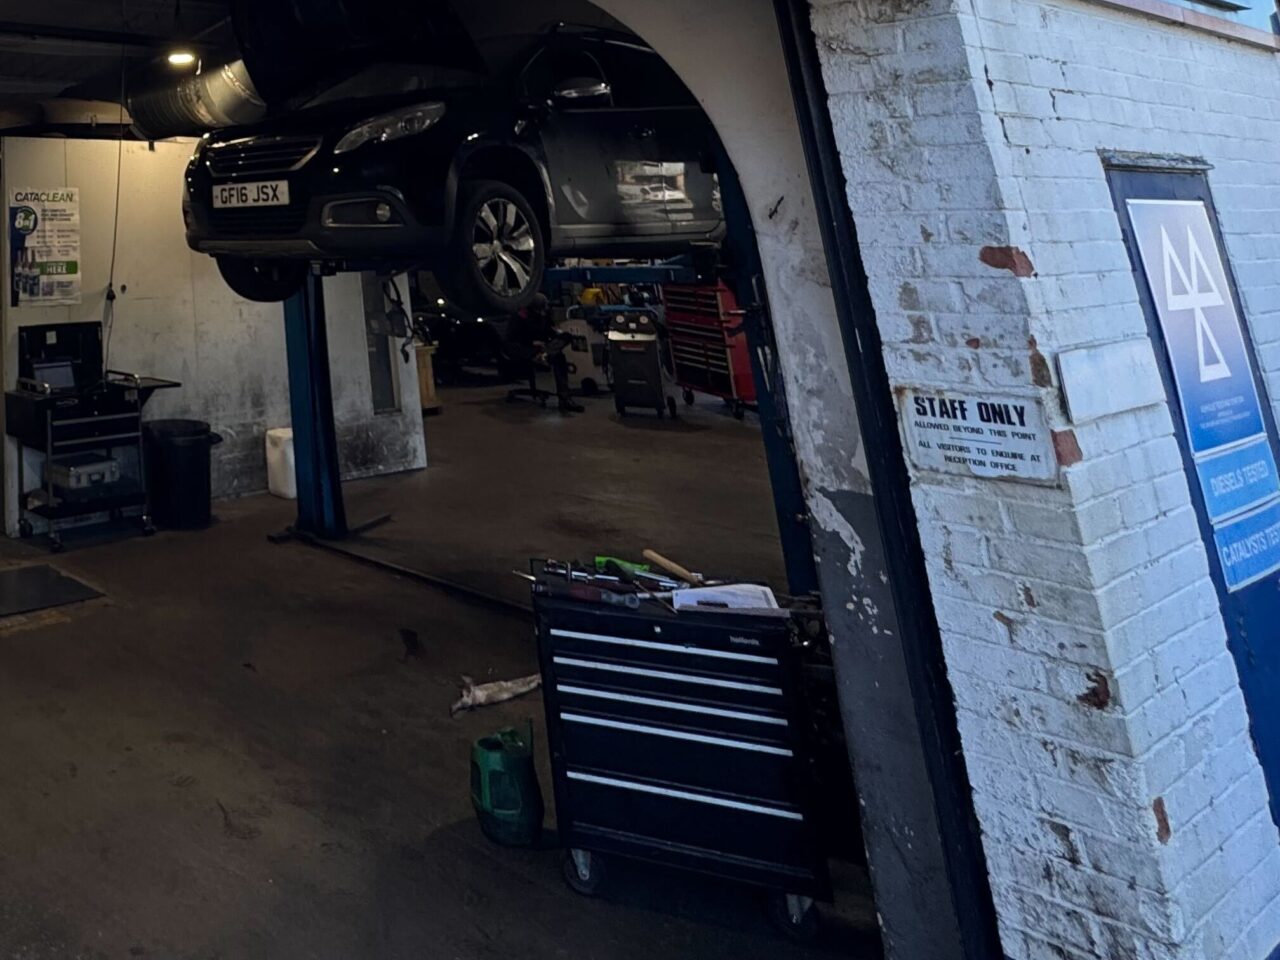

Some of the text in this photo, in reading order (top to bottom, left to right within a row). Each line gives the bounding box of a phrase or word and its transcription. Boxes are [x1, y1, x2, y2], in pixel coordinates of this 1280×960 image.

[15, 191, 74, 202] CATACLEAN
[221, 184, 280, 204] GF16 JSX
[914, 396, 1026, 427] STAFF ONLY
[914, 421, 1037, 440] ALLOWED BEYOND THIS POINT
[918, 440, 1040, 462] ALL VISITORS TO ENQUIRE AT
[944, 454, 1017, 472] RECEPTION OFFICE
[1210, 460, 1269, 497] DIESELS TESTED
[1222, 530, 1267, 567] CATALYSTS
